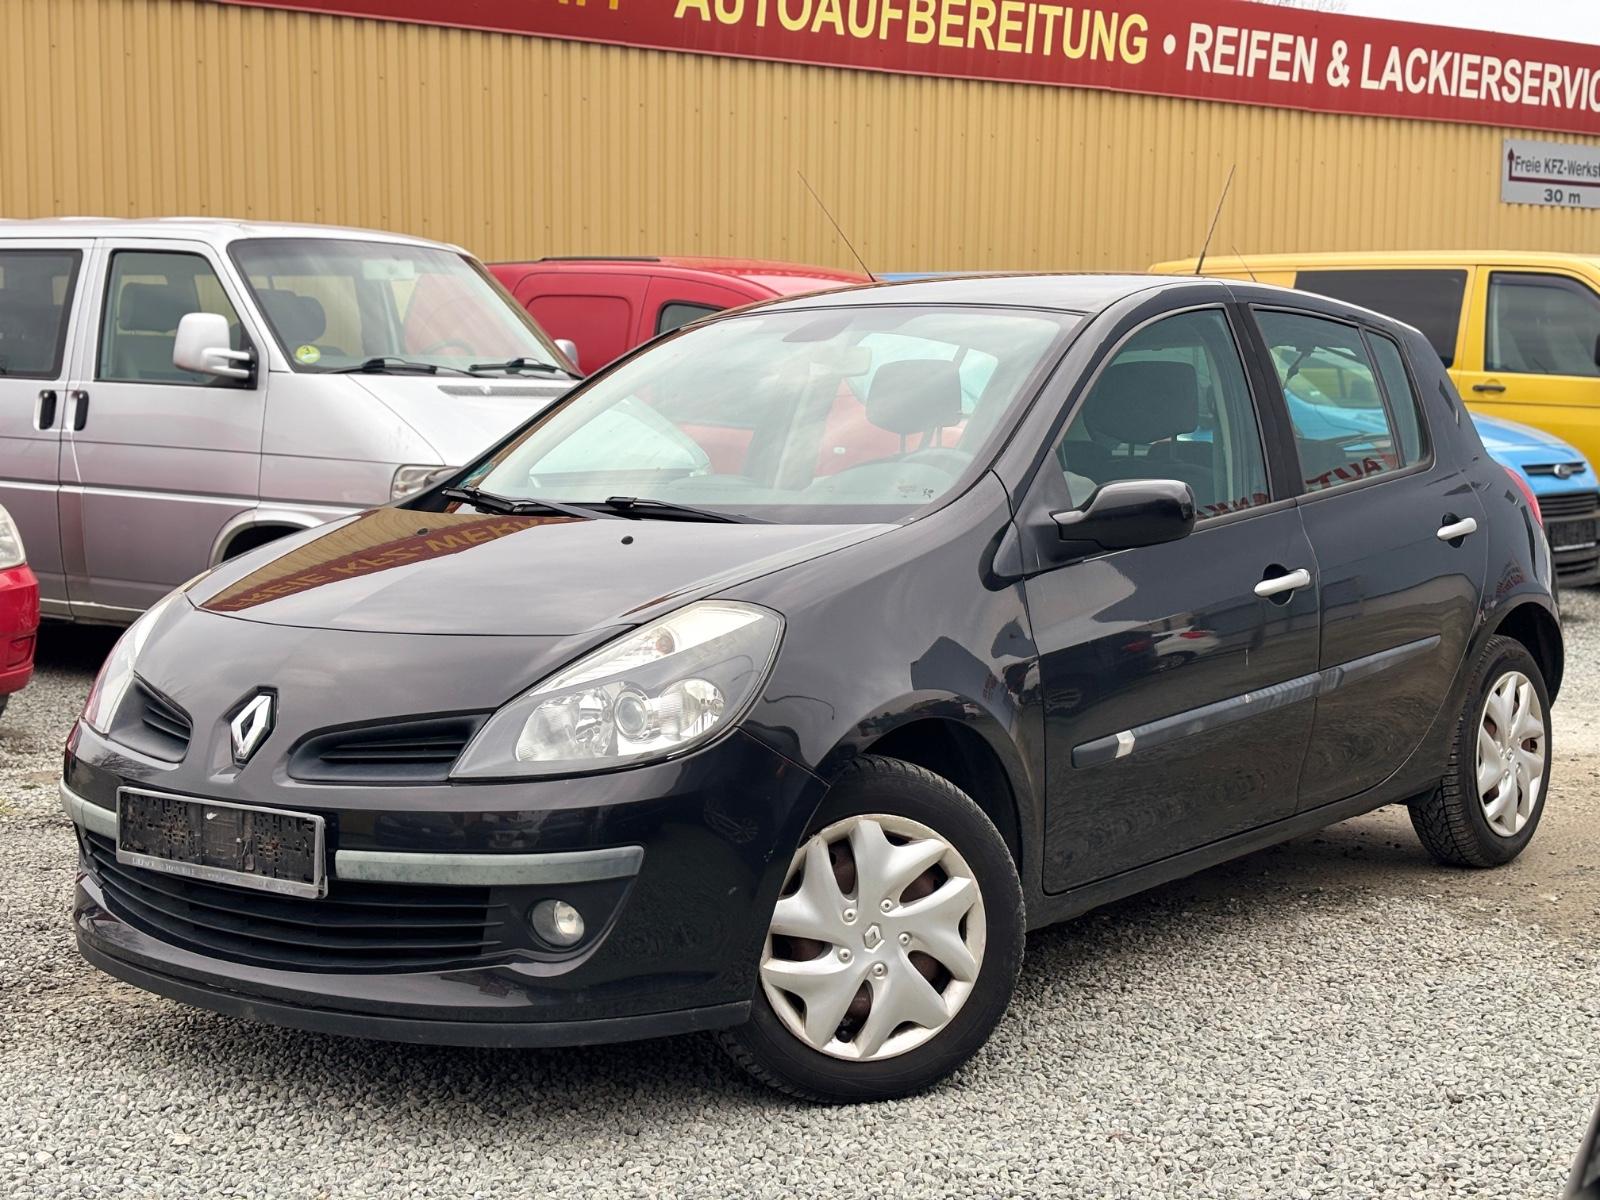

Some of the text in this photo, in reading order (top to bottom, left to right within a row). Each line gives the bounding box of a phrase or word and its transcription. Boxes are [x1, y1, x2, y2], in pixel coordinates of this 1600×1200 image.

[1186, 22, 1318, 84] REIFEN
[1326, 39, 1350, 88] &
[1514, 156, 1541, 173] Freie
[1544, 188, 1581, 204] 30 m
